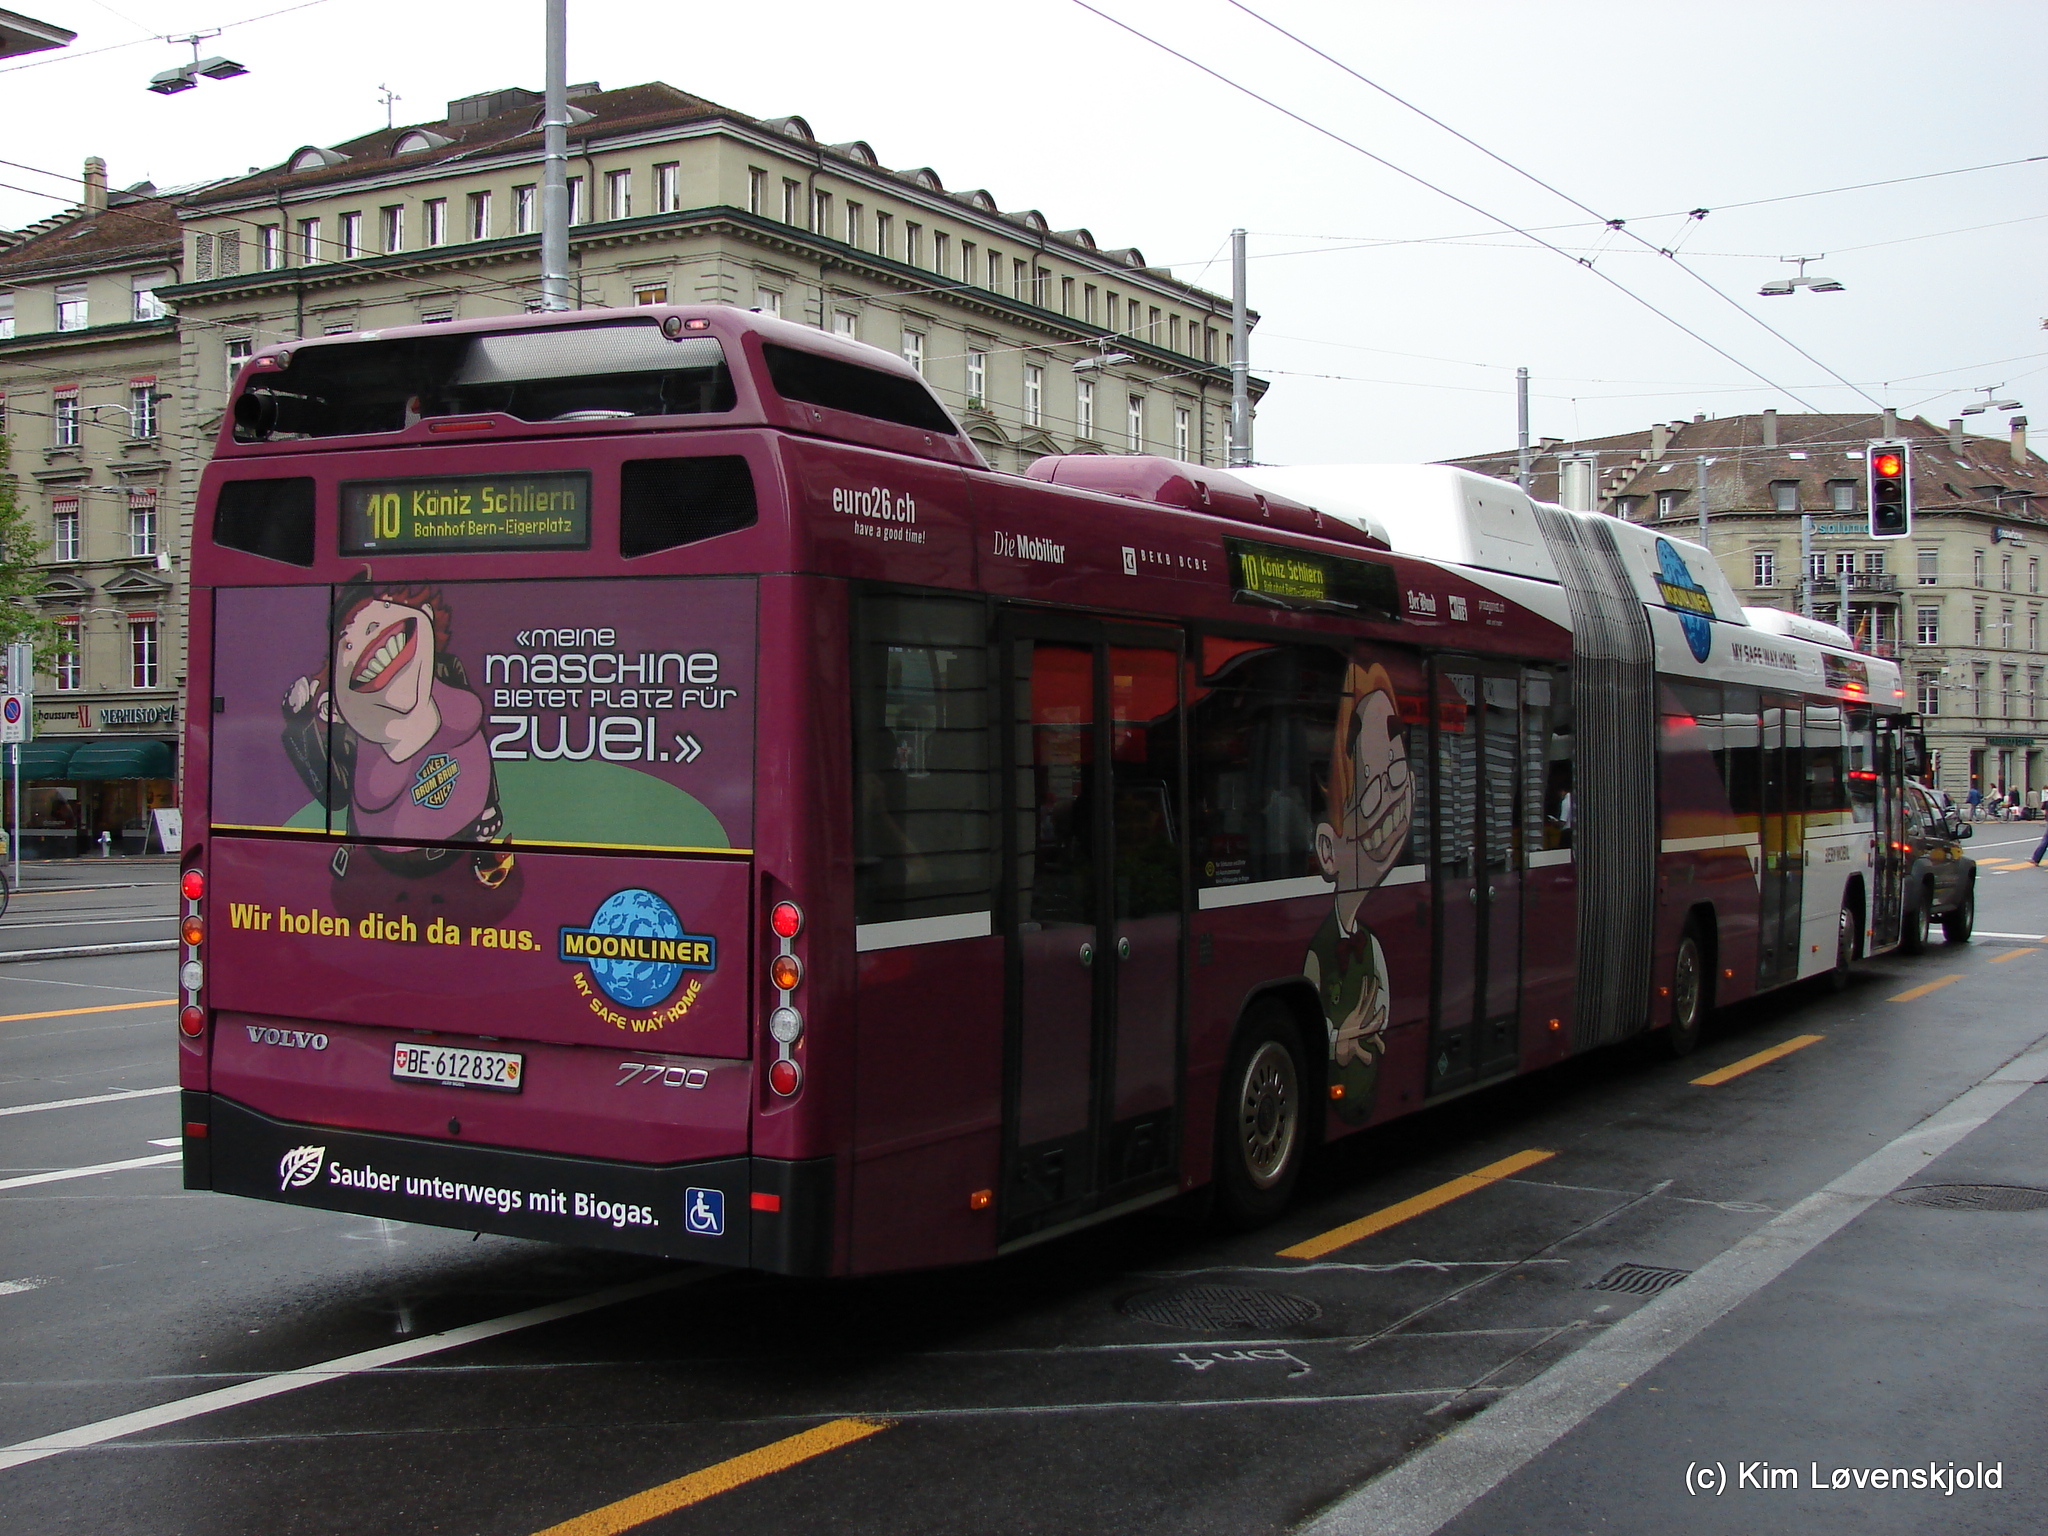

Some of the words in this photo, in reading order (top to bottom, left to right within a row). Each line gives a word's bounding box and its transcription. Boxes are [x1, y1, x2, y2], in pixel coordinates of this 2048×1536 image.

[366, 493, 401, 539] 10
[413, 489, 471, 516] Köniz
[481, 485, 575, 514] Schliern
[832, 486, 916, 524] euro26.ch
[414, 521, 465, 537] Bahnhof
[468, 517, 572, 535] Bern-Eigerplatz
[854, 521, 874, 538] have
[876, 526, 882, 539] a
[883, 525, 903, 543] good
[904, 527, 926, 545] time!
[993, 530, 1016, 558] Die
[1016, 534, 1066, 565] Mobiliar
[1140, 549, 1171, 566] BEKB
[1179, 554, 1208, 571] BCBE
[1242, 554, 1259, 590] 10
[1287, 560, 1323, 584] Schliern
[1732, 643, 1742, 661] MY
[1744, 645, 1763, 665] SAFE
[34, 709, 79, 720] haussures
[78, 705, 92, 728] XL
[100, 706, 158, 724] MEPHISTO
[415, 777, 437, 799] BRUM
[437, 763, 457, 784] BRUM
[422, 757, 446, 778] BIKER
[429, 783, 452, 804] CHICK
[230, 903, 272, 930] Wir
[279, 906, 350, 936] holen
[359, 912, 417, 941] dich
[427, 917, 460, 945] da
[471, 926, 541, 951] raus.
[565, 934, 710, 963] MOONLINER
[573, 971, 593, 997] MY
[589, 998, 627, 1030] SAFE
[631, 1015, 665, 1033] WAY
[667, 978, 702, 1023] HOME
[246, 1025, 329, 1050] VOLVO
[616, 1062, 709, 1090] 7700
[329, 1161, 400, 1192] Sauber
[405, 1179, 522, 1213] unterwegs
[528, 1188, 567, 1214] mit
[574, 1192, 660, 1229] Biogas.
